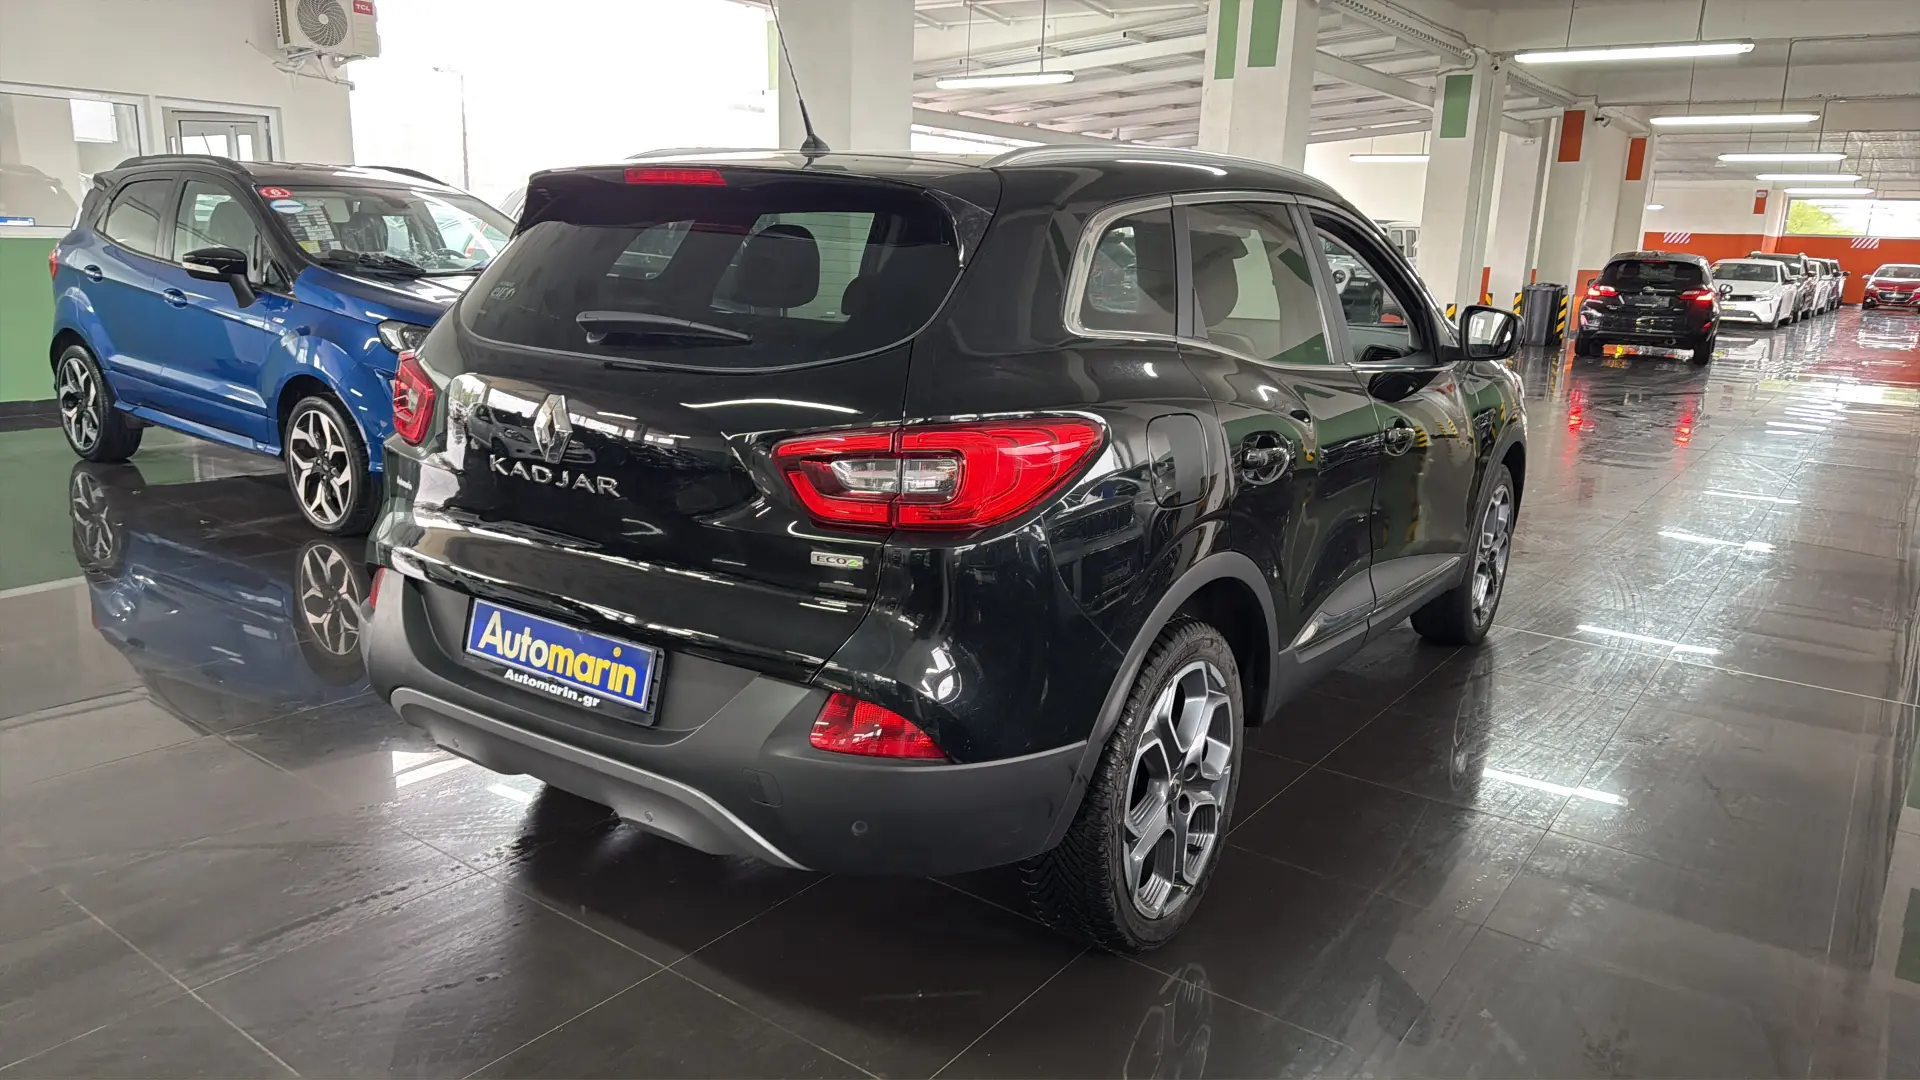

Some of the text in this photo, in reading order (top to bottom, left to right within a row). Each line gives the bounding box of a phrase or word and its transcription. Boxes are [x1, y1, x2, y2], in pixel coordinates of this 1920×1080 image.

[355, 3, 371, 12] TCL
[489, 454, 621, 498] KADJAR
[477, 610, 637, 697] Automarin
[504, 669, 600, 707] Automarin.gr
